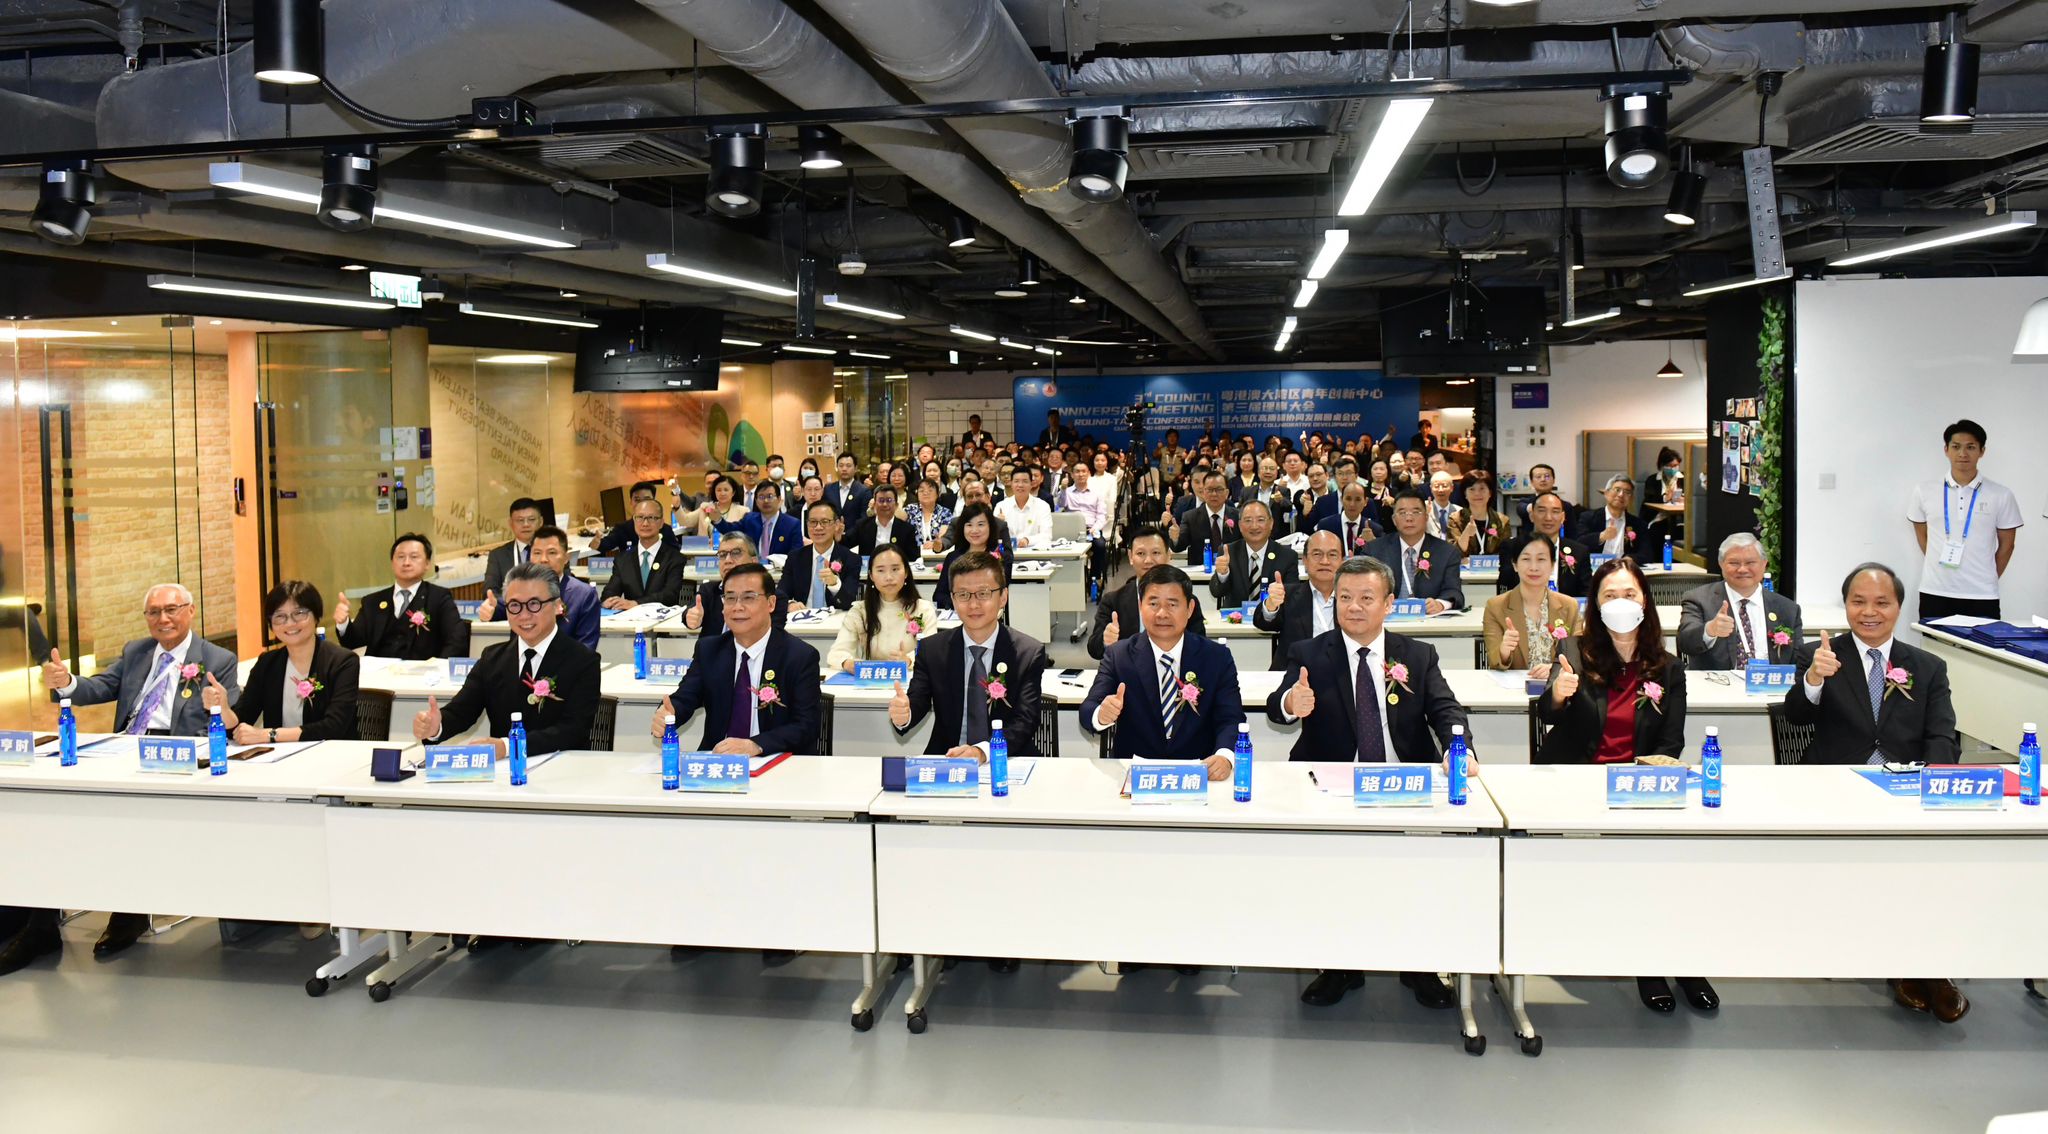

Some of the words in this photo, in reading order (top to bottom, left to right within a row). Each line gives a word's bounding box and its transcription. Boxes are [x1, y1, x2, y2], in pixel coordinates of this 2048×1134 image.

[1155, 393, 1214, 403] COUNCIL
[1051, 406, 1148, 416] NNIVERSA
[1151, 404, 1215, 414] MEETING
[1074, 417, 1146, 427] ROUND-TA
[1147, 416, 1214, 425] CONFERENCE
[431, 753, 489, 769] 严志明
[687, 762, 744, 779] 李家华
[1138, 773, 1201, 790] 邱克楠
[1361, 775, 1425, 792] 骆少明
[1928, 777, 1997, 795] 邓祐才
